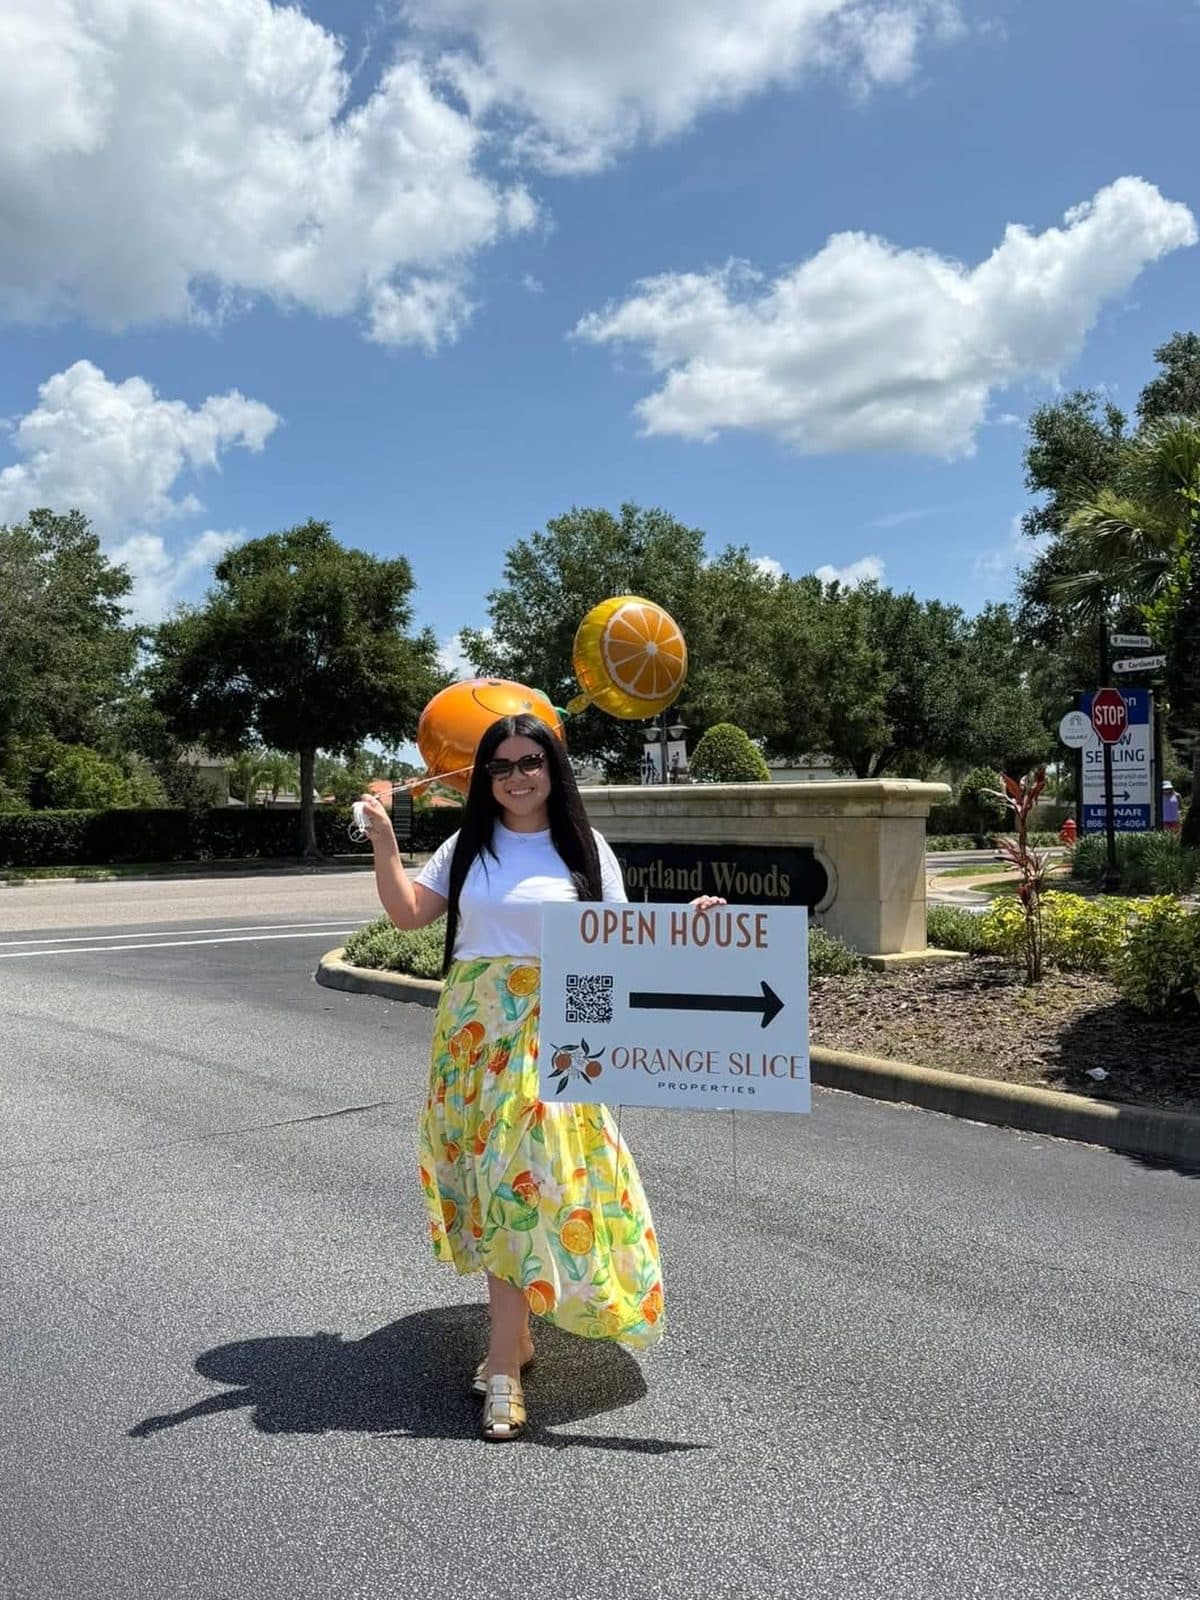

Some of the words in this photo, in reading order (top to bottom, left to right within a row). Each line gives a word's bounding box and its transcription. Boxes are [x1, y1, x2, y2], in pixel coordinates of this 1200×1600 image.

[1095, 705, 1125, 726] STOP
[1085, 748, 1145, 764] SELING
[1090, 807, 1142, 817] LENAR
[1086, 819, 1146, 828] 866-2-4064
[712, 862, 791, 897] Woods
[580, 909, 656, 945] OPEN
[671, 911, 768, 949] HOUSE
[611, 1046, 720, 1075] ORANGE
[728, 1051, 805, 1080] SLICE
[657, 1081, 757, 1095] PROPERTIES
